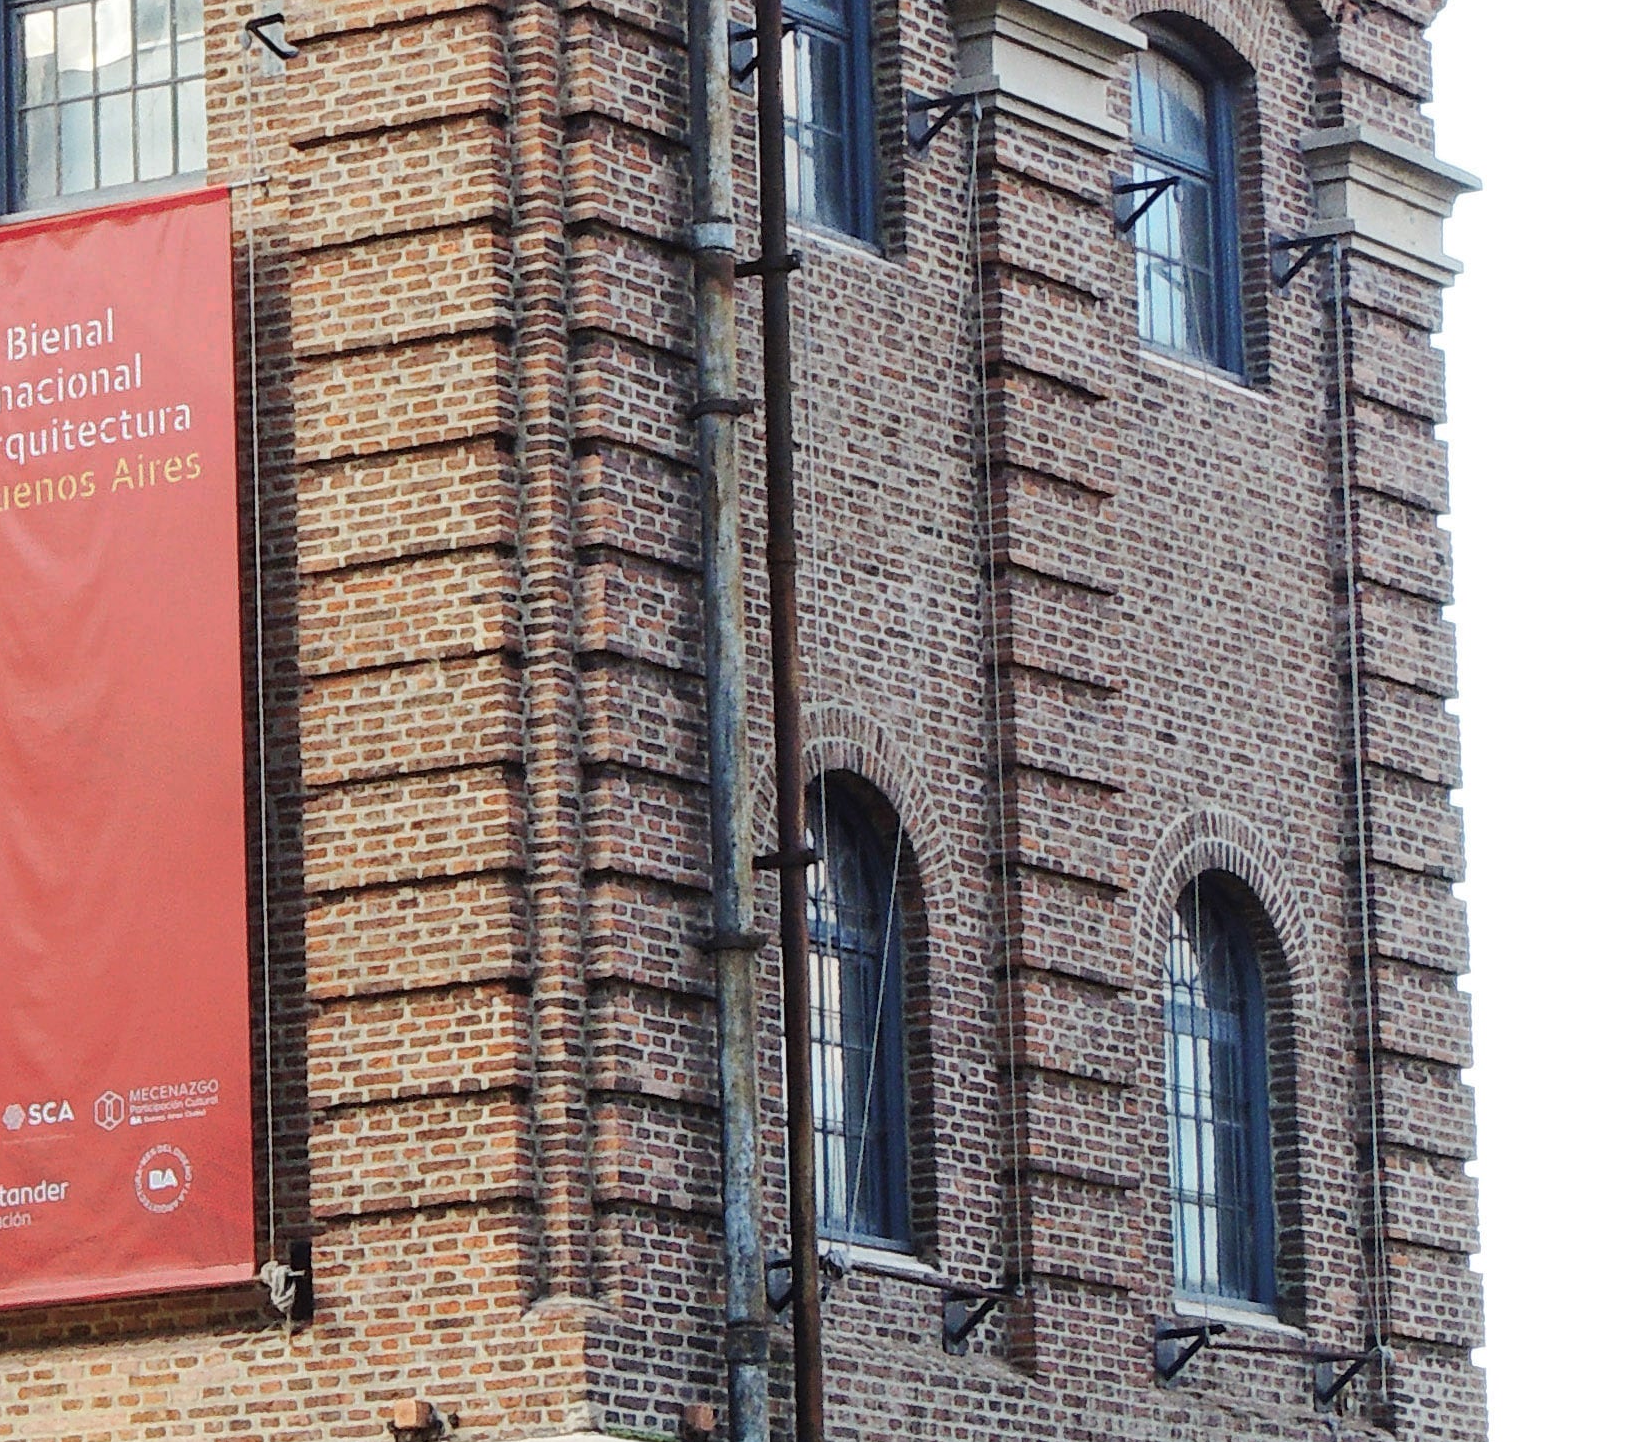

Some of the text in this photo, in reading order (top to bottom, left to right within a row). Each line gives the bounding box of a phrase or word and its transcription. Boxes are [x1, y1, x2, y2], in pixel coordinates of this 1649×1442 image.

[7, 307, 114, 361] Bienal
[111, 452, 201, 493] Aires
[129, 1079, 219, 1101] MECENAZGO
[27, 1099, 75, 1126] SCA
